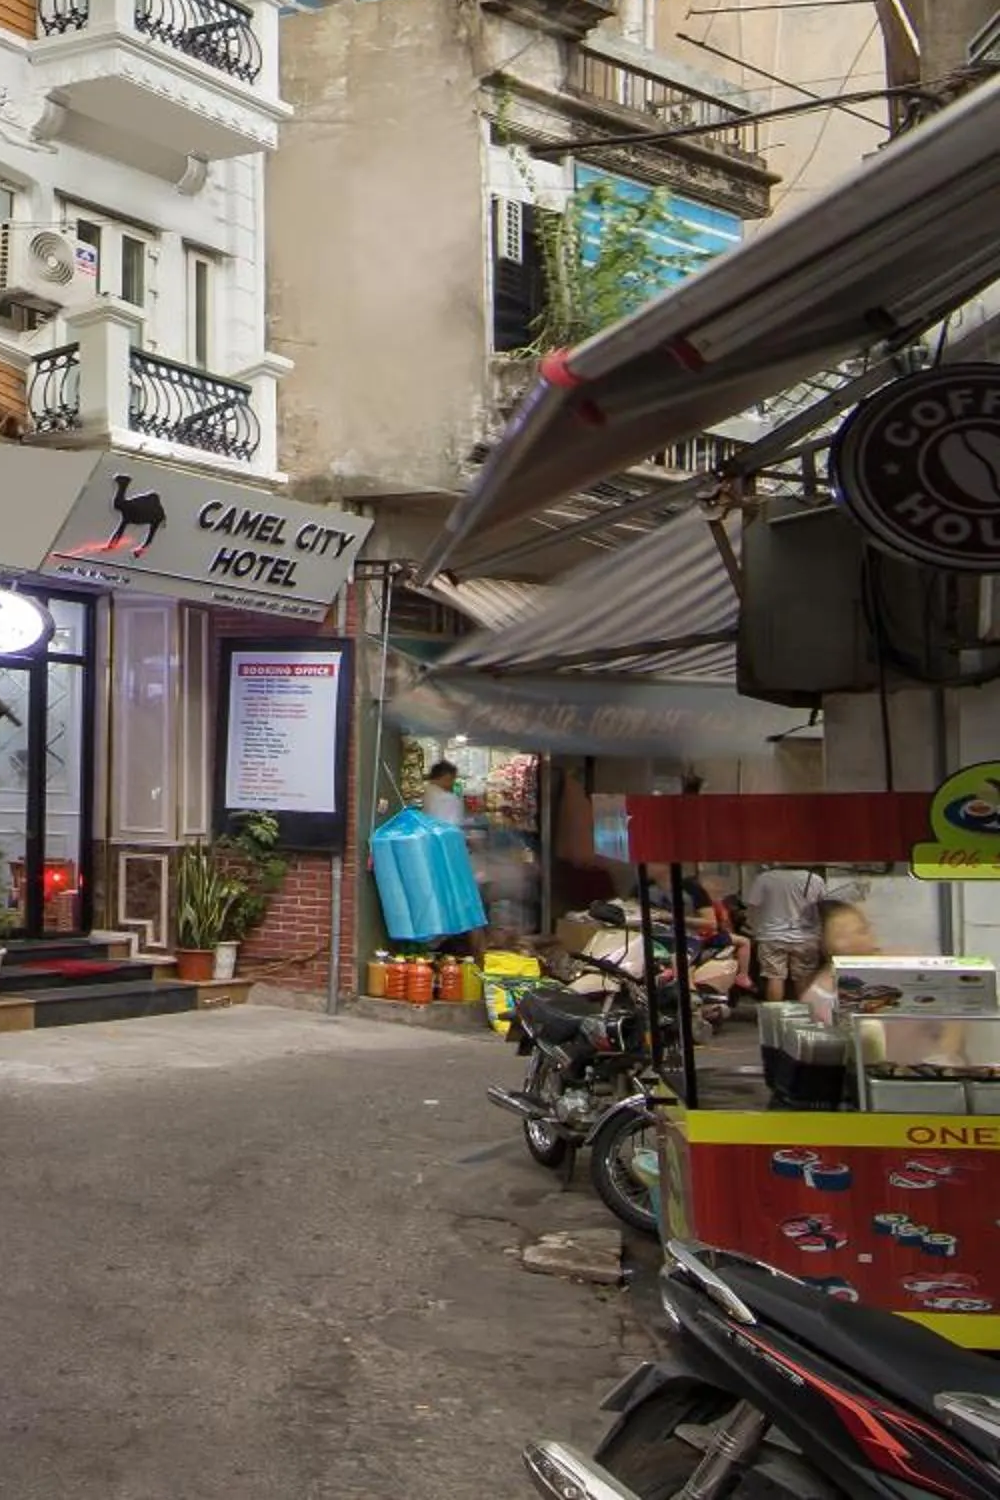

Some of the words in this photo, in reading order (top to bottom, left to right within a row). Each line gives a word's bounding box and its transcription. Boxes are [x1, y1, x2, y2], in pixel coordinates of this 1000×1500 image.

[198, 500, 287, 546] CAMEL
[295, 522, 356, 558] CITY
[208, 546, 298, 587] HOTEL
[242, 665, 292, 675] BOOKING
[294, 666, 329, 676] OFFICE
[906, 1126, 1000, 1145] ONE
